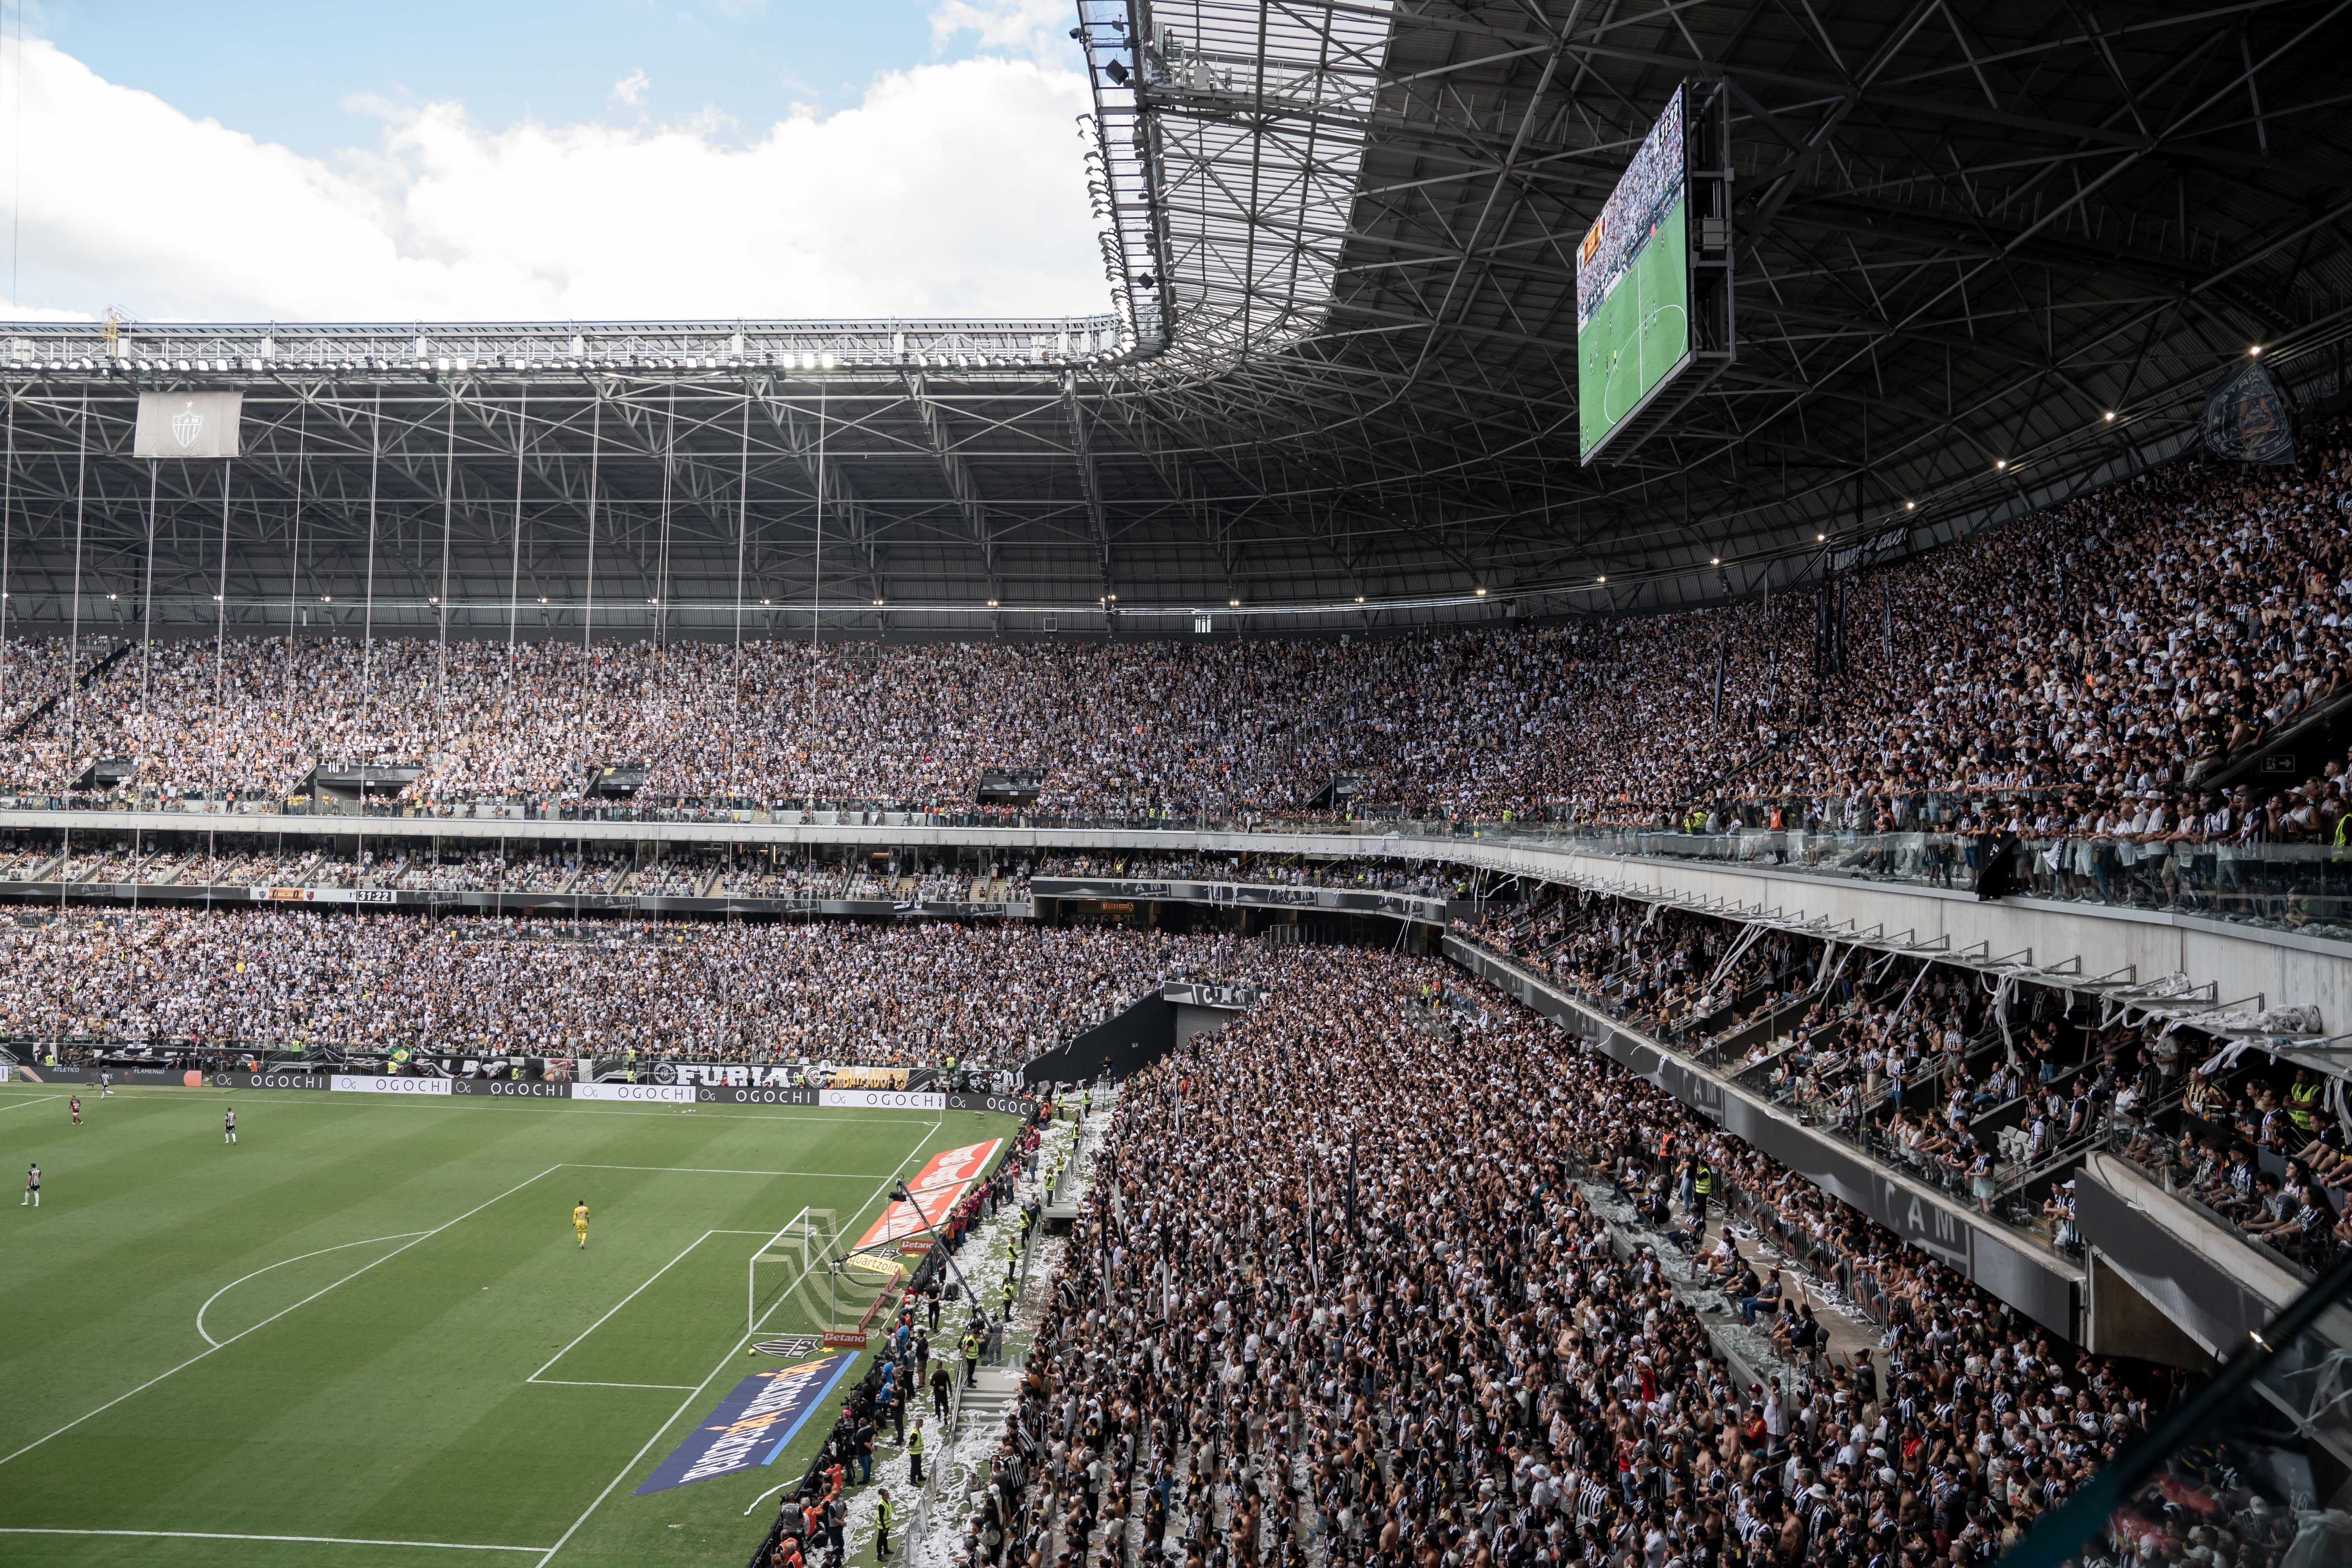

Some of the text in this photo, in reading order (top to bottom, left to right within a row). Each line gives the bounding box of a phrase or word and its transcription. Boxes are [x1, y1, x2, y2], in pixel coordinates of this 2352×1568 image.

[1660, 103, 1678, 143] 31:22
[68, 884, 106, 895] CAM
[293, 891, 299, 899] 0
[1121, 883, 1161, 895] CAM
[359, 891, 388, 901] 31:22
[414, 892, 453, 904] CAM
[591, 895, 631, 908] CAM
[771, 900, 812, 912] CAM
[956, 903, 997, 915] CAM
[251, 1074, 322, 1089] OGOCHI
[675, 1065, 791, 1088] FURIA
[376, 1079, 447, 1092] OGOCHI
[490, 1082, 563, 1096] OGOCHI
[618, 1087, 691, 1100] OGOCHI
[736, 1090, 810, 1103] OGOCHI
[1885, 1180, 1955, 1243] CAM
[849, 1256, 900, 1274] quartzolit
[824, 1333, 865, 1342] Betano
[790, 1340, 812, 1356] CAM
[678, 1407, 796, 1483] betnacional
